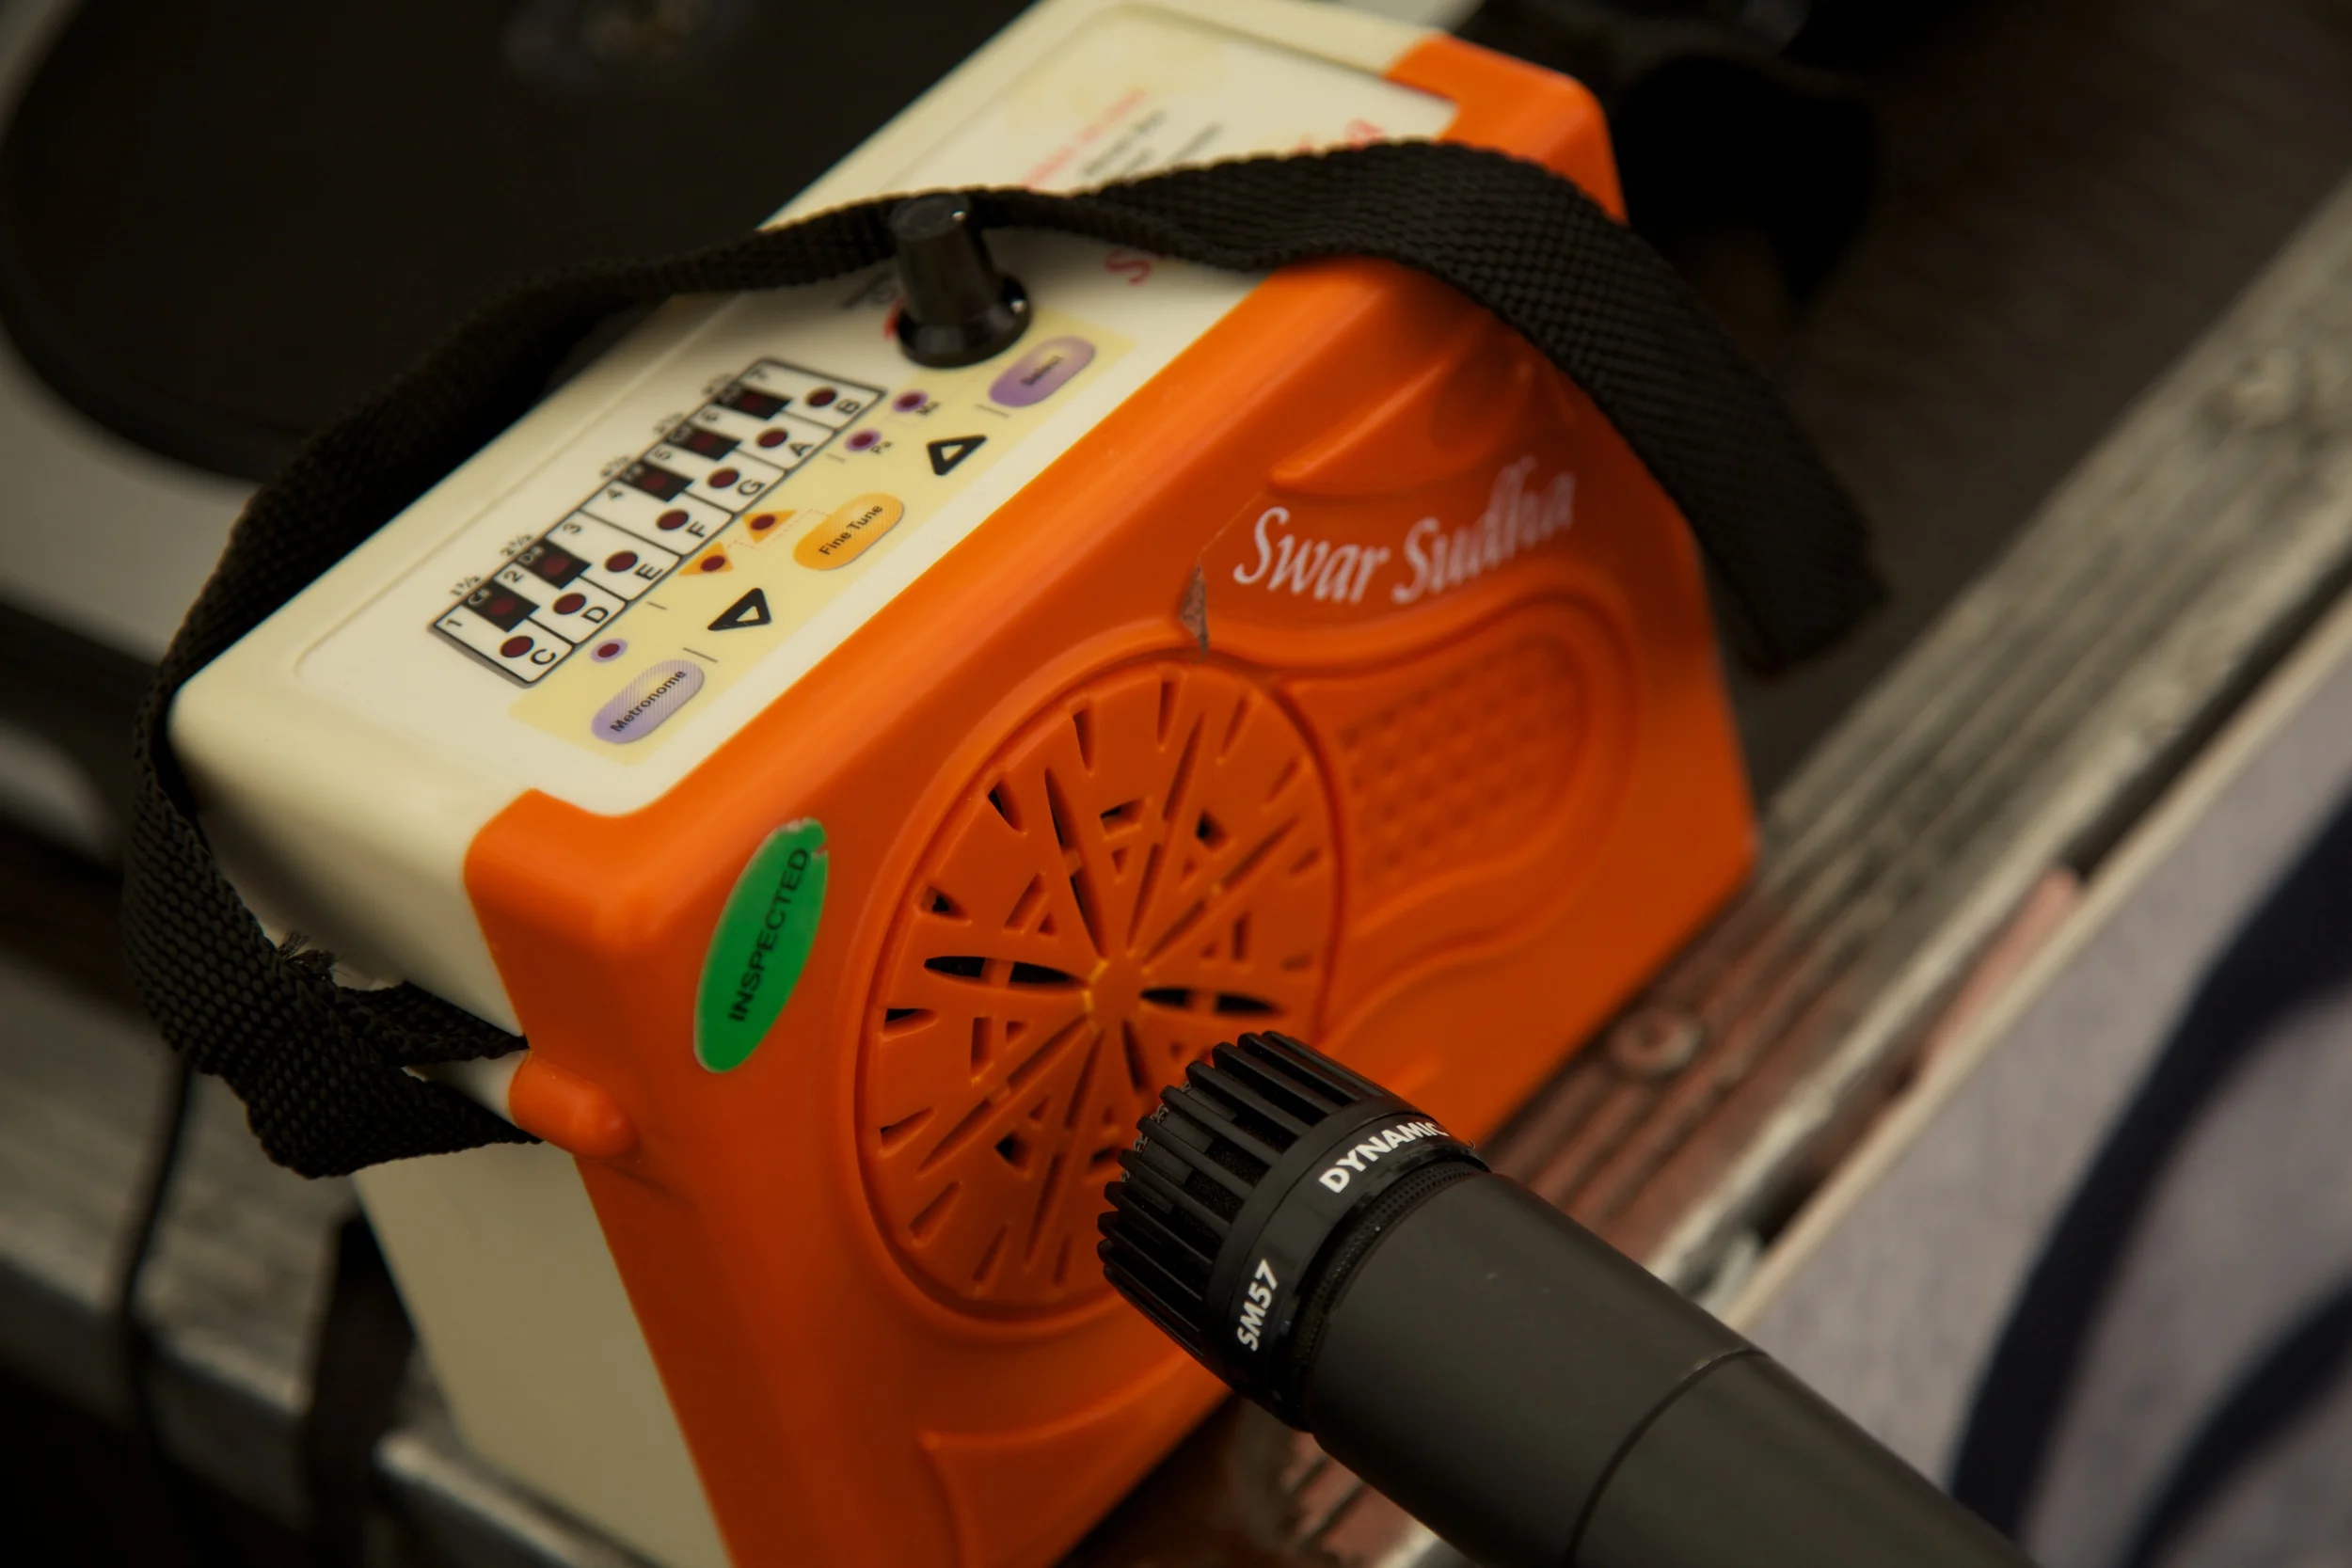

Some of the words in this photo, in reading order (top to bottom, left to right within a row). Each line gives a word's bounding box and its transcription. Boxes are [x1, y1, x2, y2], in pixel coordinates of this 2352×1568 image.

[833, 399, 862, 415] B
[654, 448, 673, 461] 5
[788, 441, 815, 457] A
[606, 486, 624, 501] 4
[736, 479, 766, 496] G
[563, 521, 582, 535] 3
[685, 521, 706, 538] F
[818, 530, 852, 556] Fine
[847, 504, 884, 531] Tune
[1233, 506, 1391, 605] Swar
[1391, 454, 1577, 605] Sudha
[502, 569, 524, 583] 2
[633, 562, 662, 581] E
[445, 617, 464, 628] 1
[580, 605, 610, 624] D
[530, 648, 557, 665] C
[610, 671, 686, 732] Metronome
[727, 848, 808, 1022] INSPECTED
[1237, 1259, 1278, 1352] SM57
